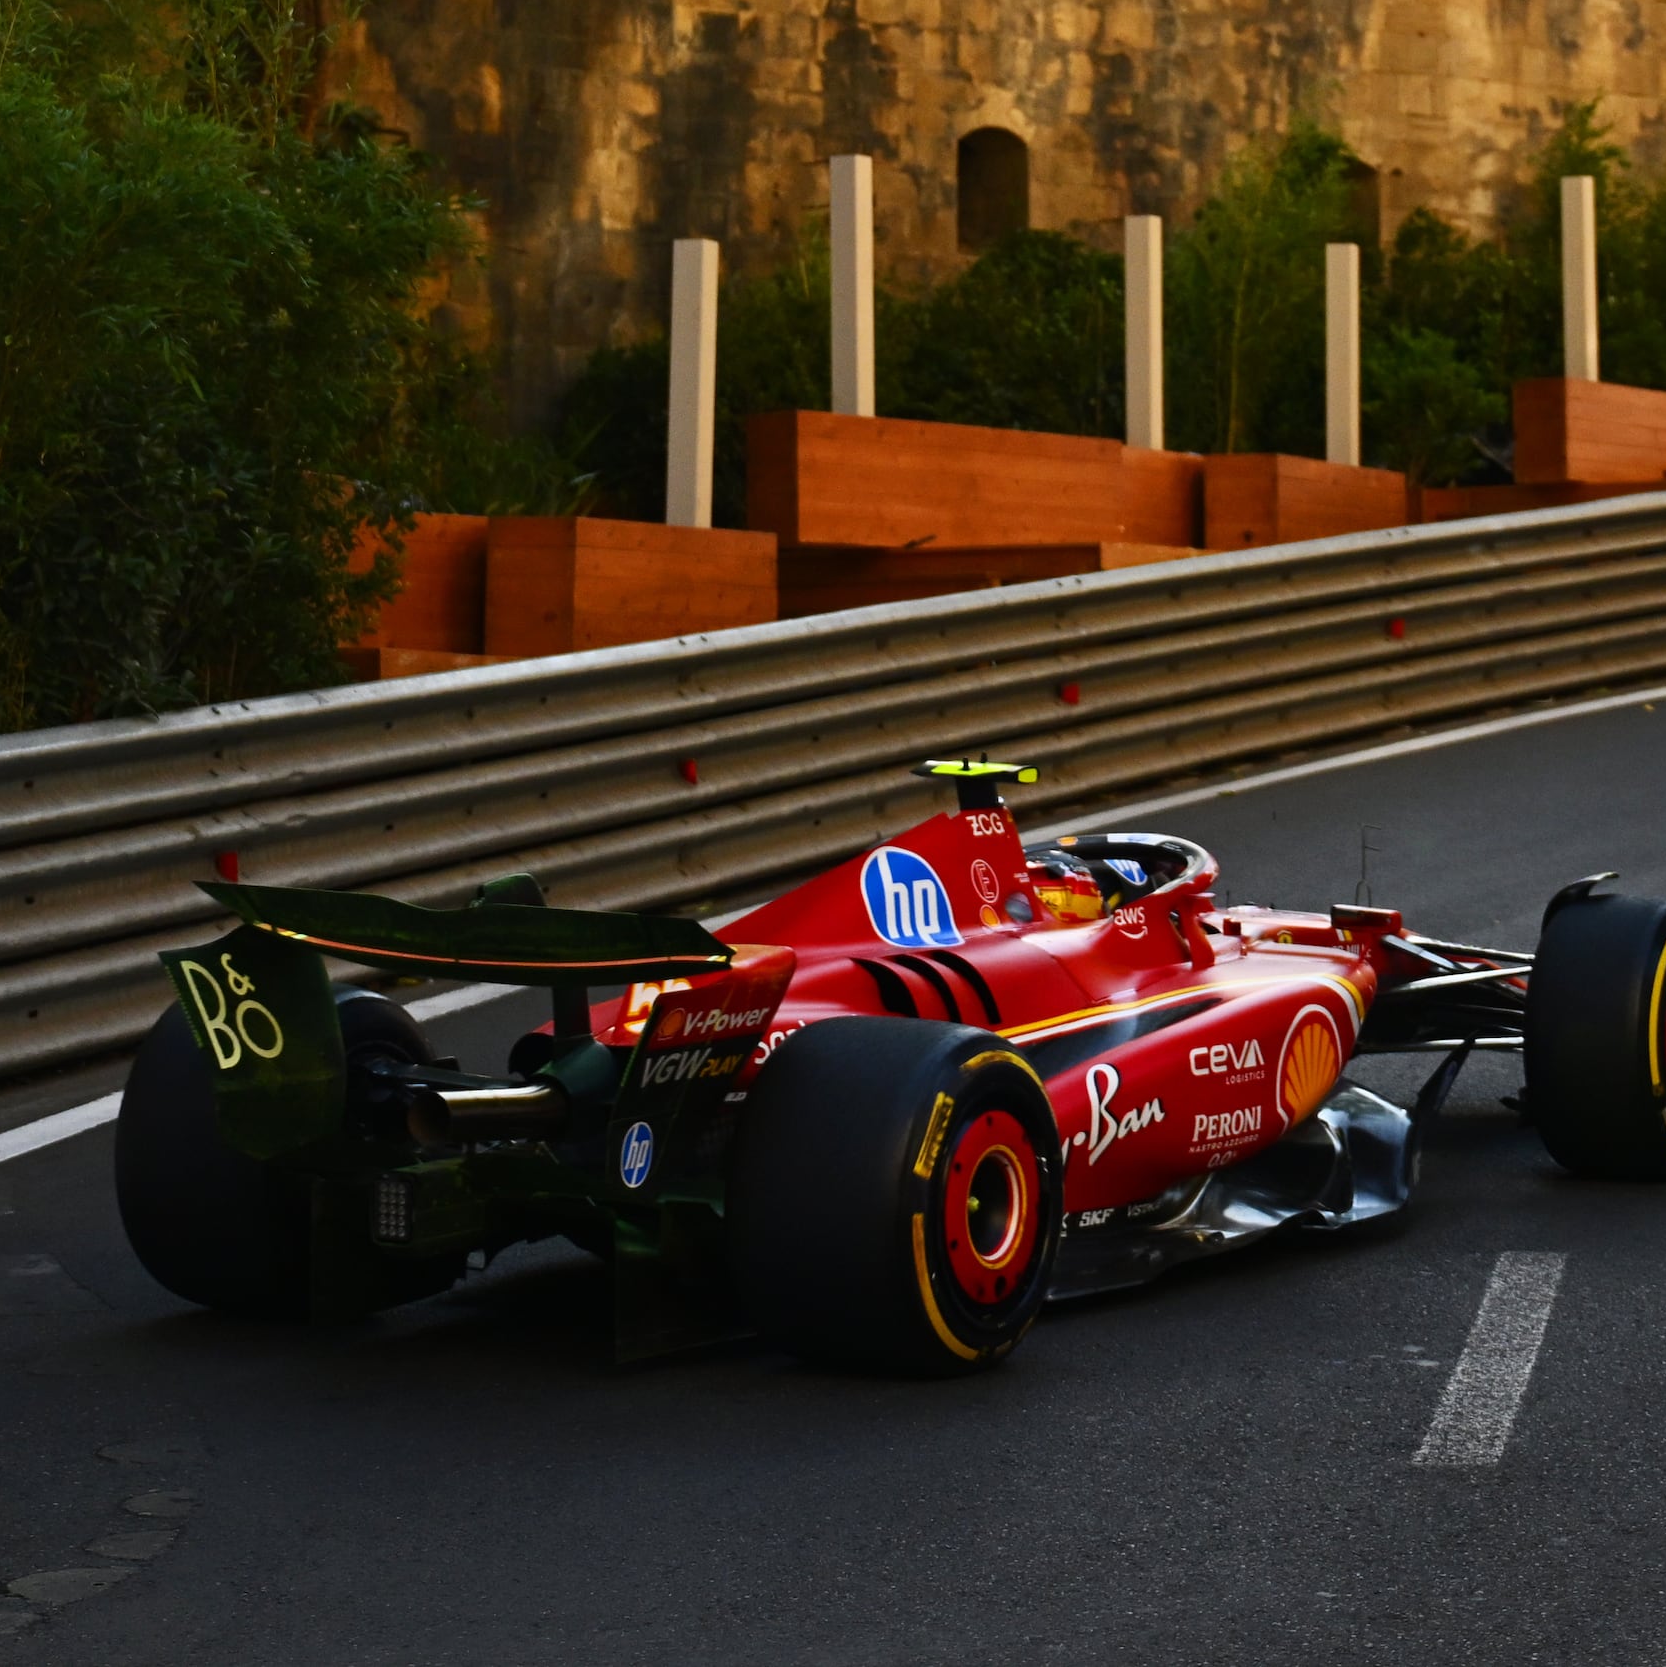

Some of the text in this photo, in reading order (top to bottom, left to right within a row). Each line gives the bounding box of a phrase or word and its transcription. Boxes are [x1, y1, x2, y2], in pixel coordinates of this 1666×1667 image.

[876, 848, 942, 946] hp
[1114, 906, 1145, 926] aws
[683, 1007, 771, 1036] V-Power
[1226, 1070, 1265, 1085] LOGISTICS
[1192, 1105, 1262, 1142] PERONI
[624, 1123, 650, 1186] hp
[1079, 1208, 1115, 1228] SKF
